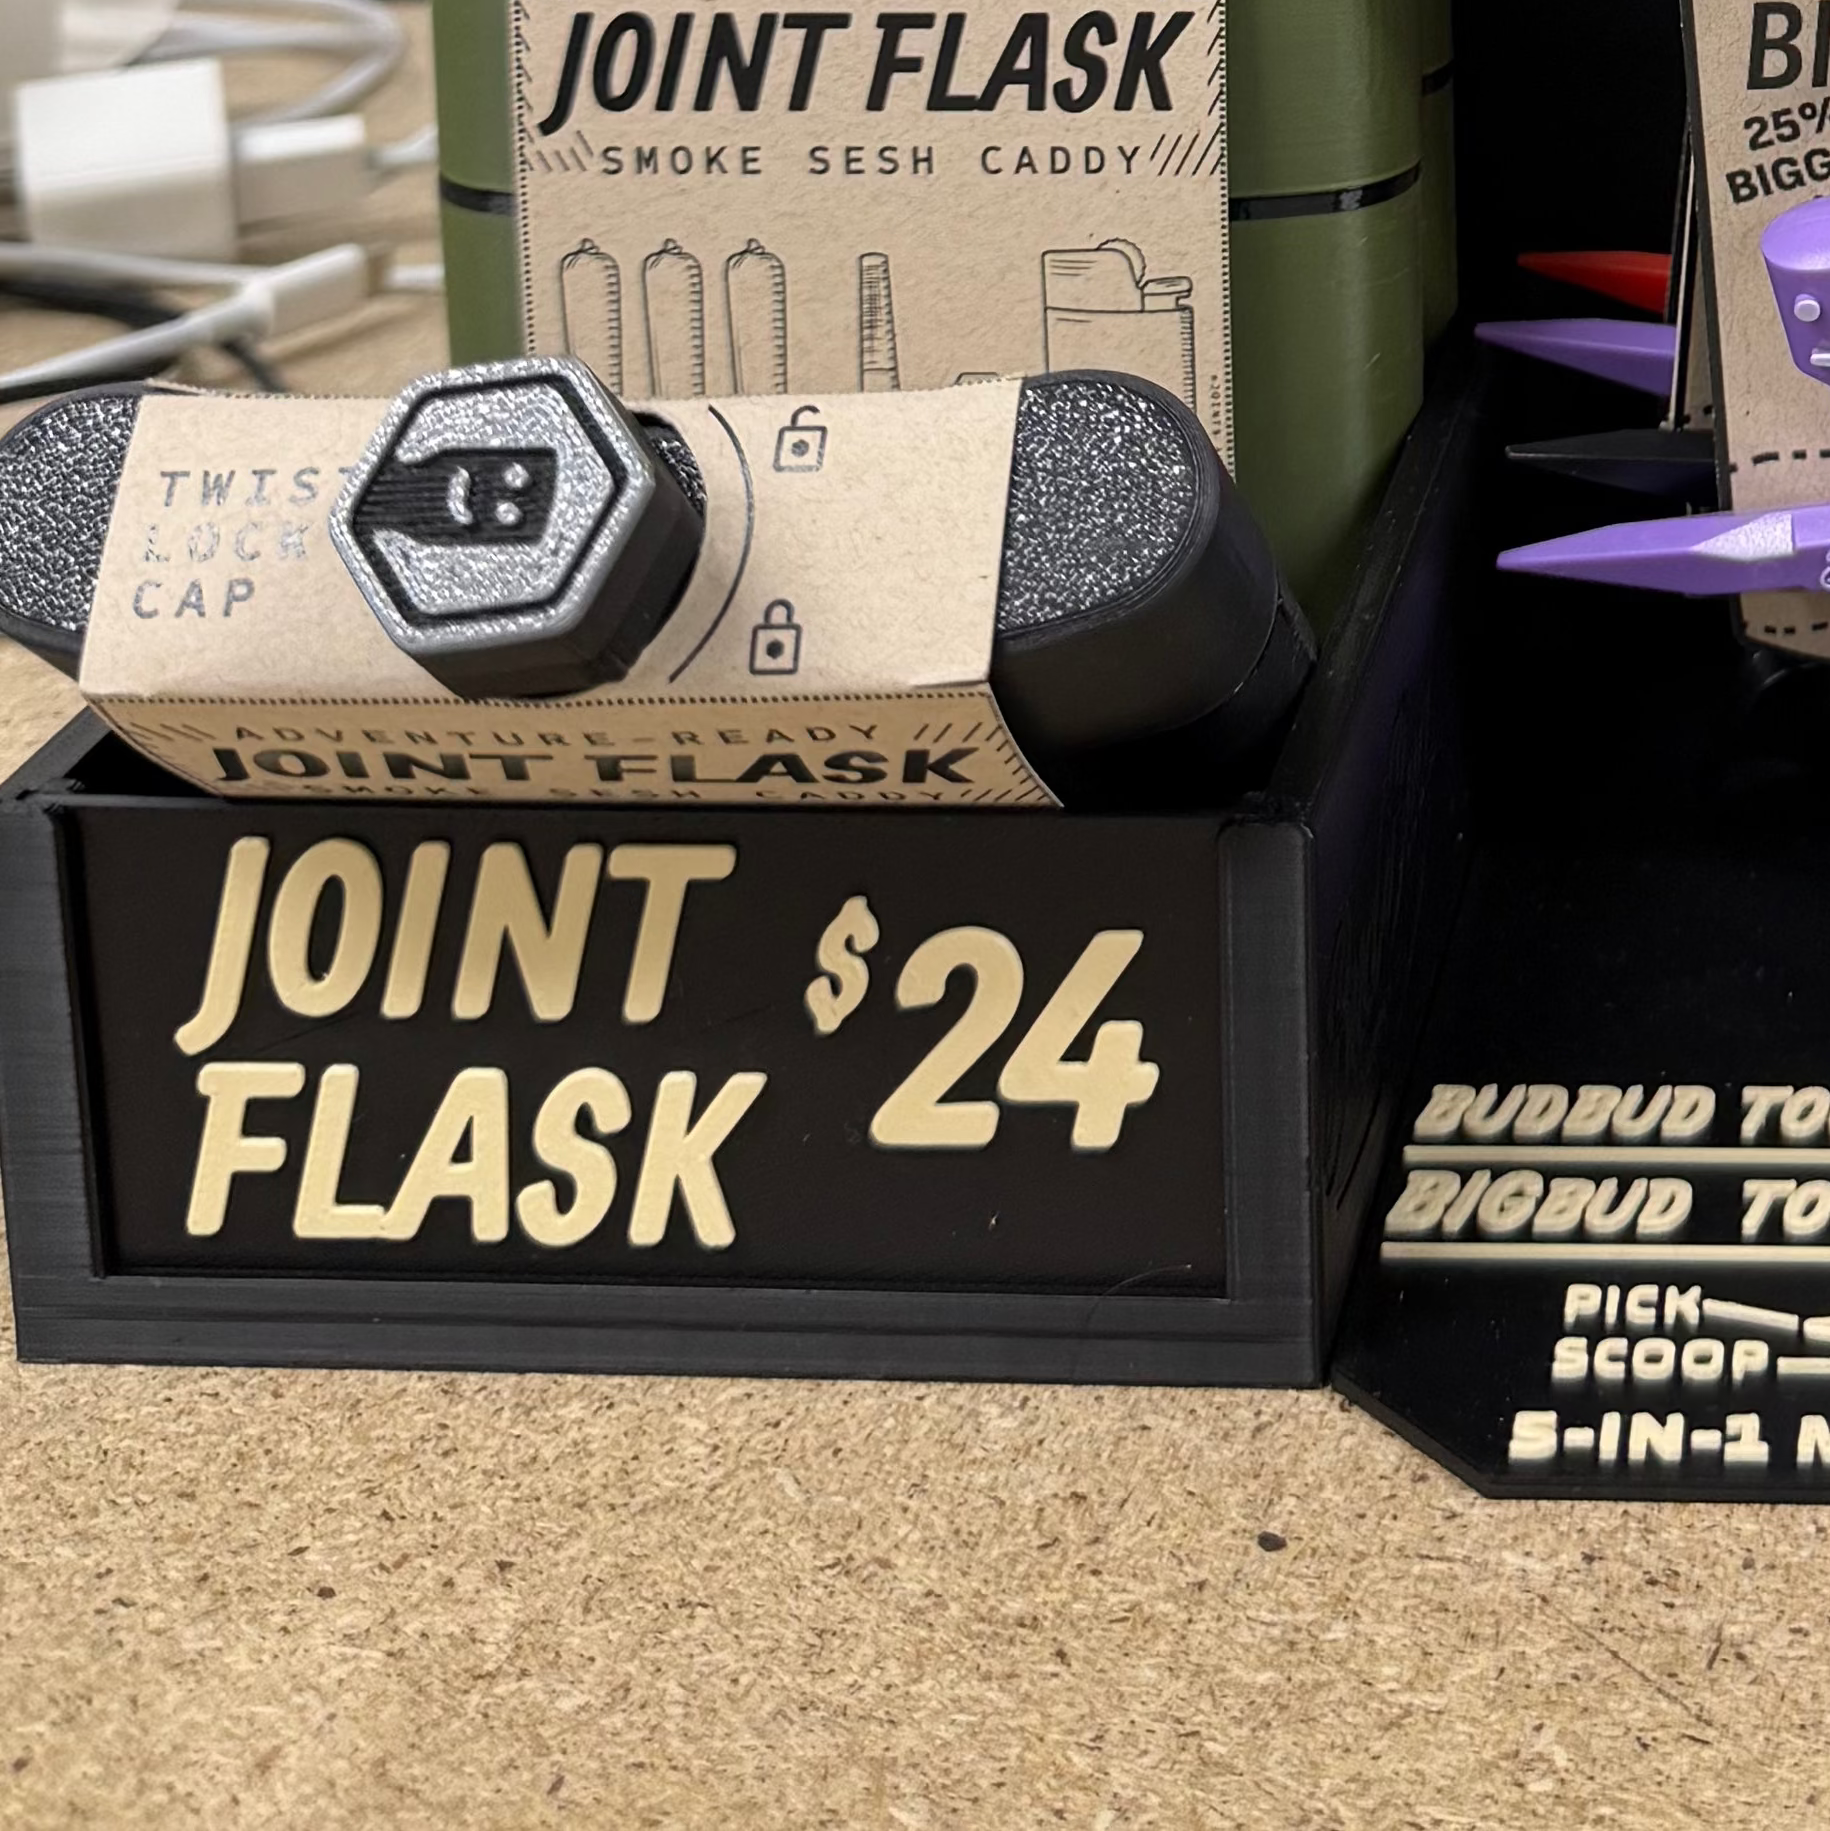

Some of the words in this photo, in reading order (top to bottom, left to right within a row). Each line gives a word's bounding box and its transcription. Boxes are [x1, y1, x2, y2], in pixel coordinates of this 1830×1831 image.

[536, 11, 850, 134] JOINT
[864, 9, 1196, 114] FLASK
[600, 144, 766, 177] SMOKE
[807, 144, 936, 177] SESH
[979, 144, 1141, 177] CADDY
[160, 466, 355, 508] TWIS
[143, 520, 310, 563] LOCK
[132, 576, 256, 619] CAP
[234, 724, 878, 747] ADVENTURE-READY
[212, 746, 554, 782] JOINT
[583, 746, 982, 785] FLASK
[173, 834, 738, 1056] JOINT
[803, 893, 1161, 1155] $24
[1412, 1081, 1718, 1143] BUDBUD
[185, 1060, 769, 1251] FLASK
[1383, 1168, 1693, 1237] BIGBUD
[1561, 1281, 1705, 1332] PICK
[1550, 1335, 1770, 1385] SCOOP
[1507, 1408, 1770, 1467] 5-IN-1
